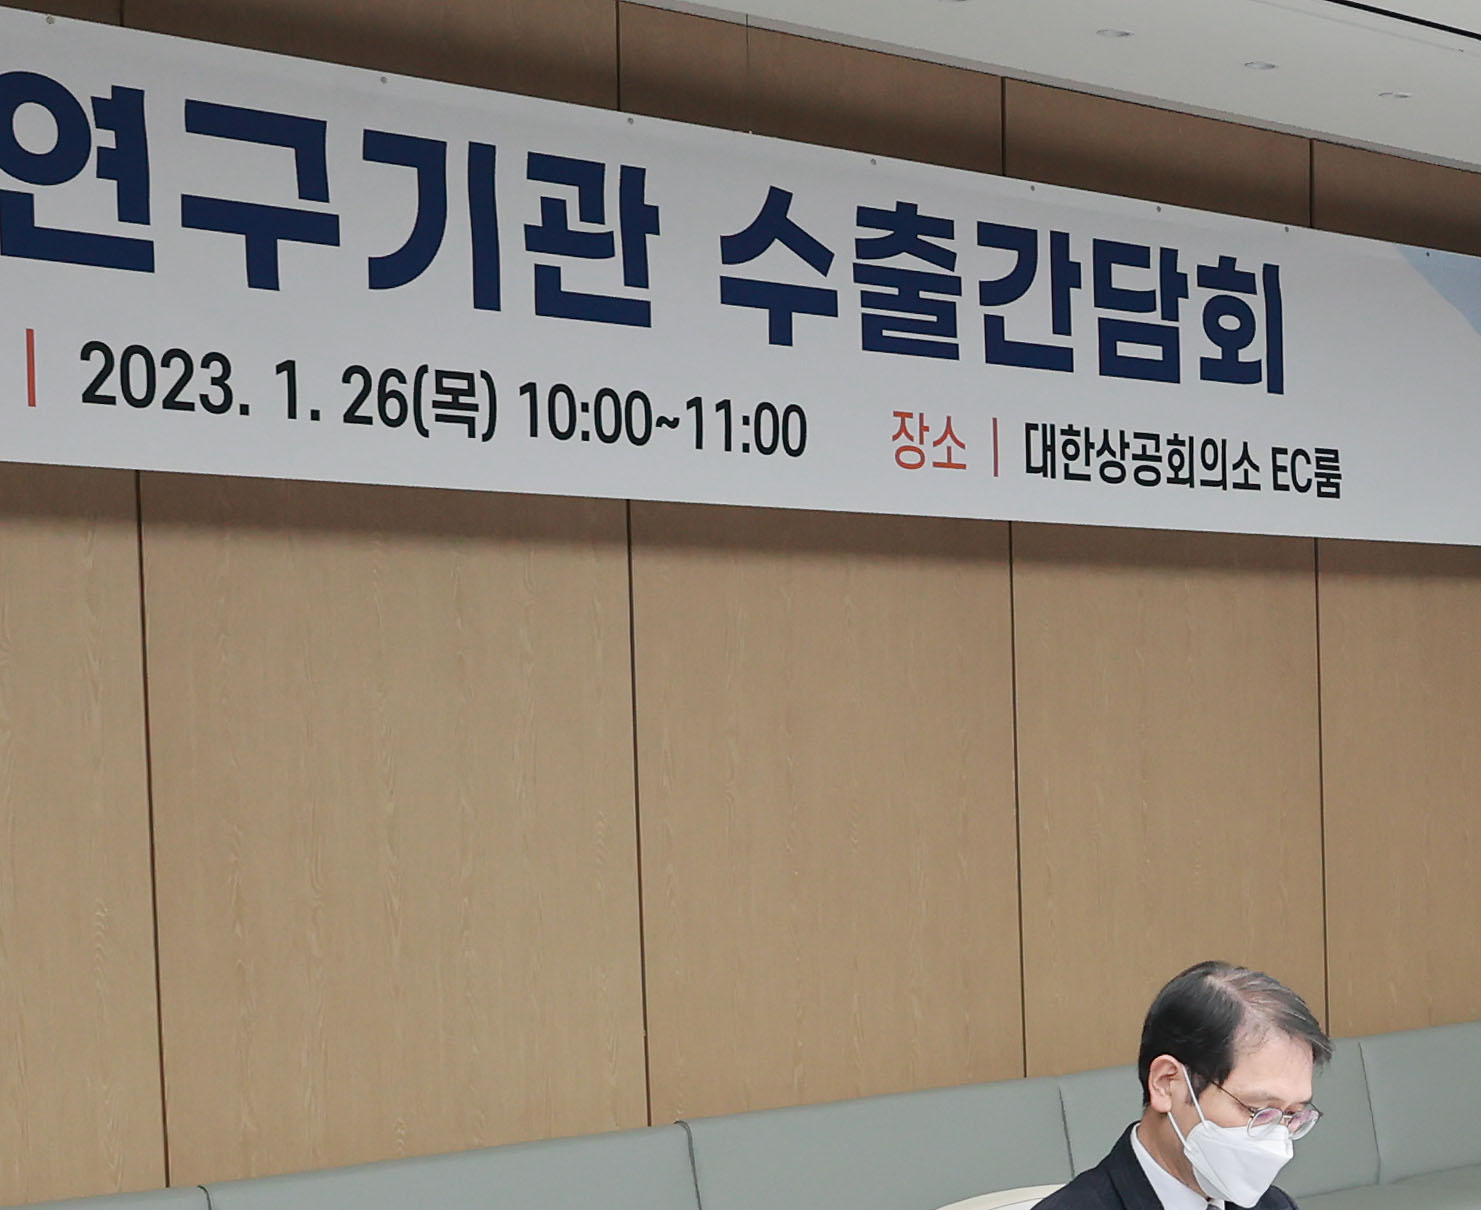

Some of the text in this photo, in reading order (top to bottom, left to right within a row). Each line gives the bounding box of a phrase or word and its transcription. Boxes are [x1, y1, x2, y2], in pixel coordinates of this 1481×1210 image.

[0, 70, 1285, 396] 연구기관 수출간담회
[80, 340, 1343, 500] 2023. 1. 26(목) 10:00~11:00 장소 대한상공회의소 EC룸
